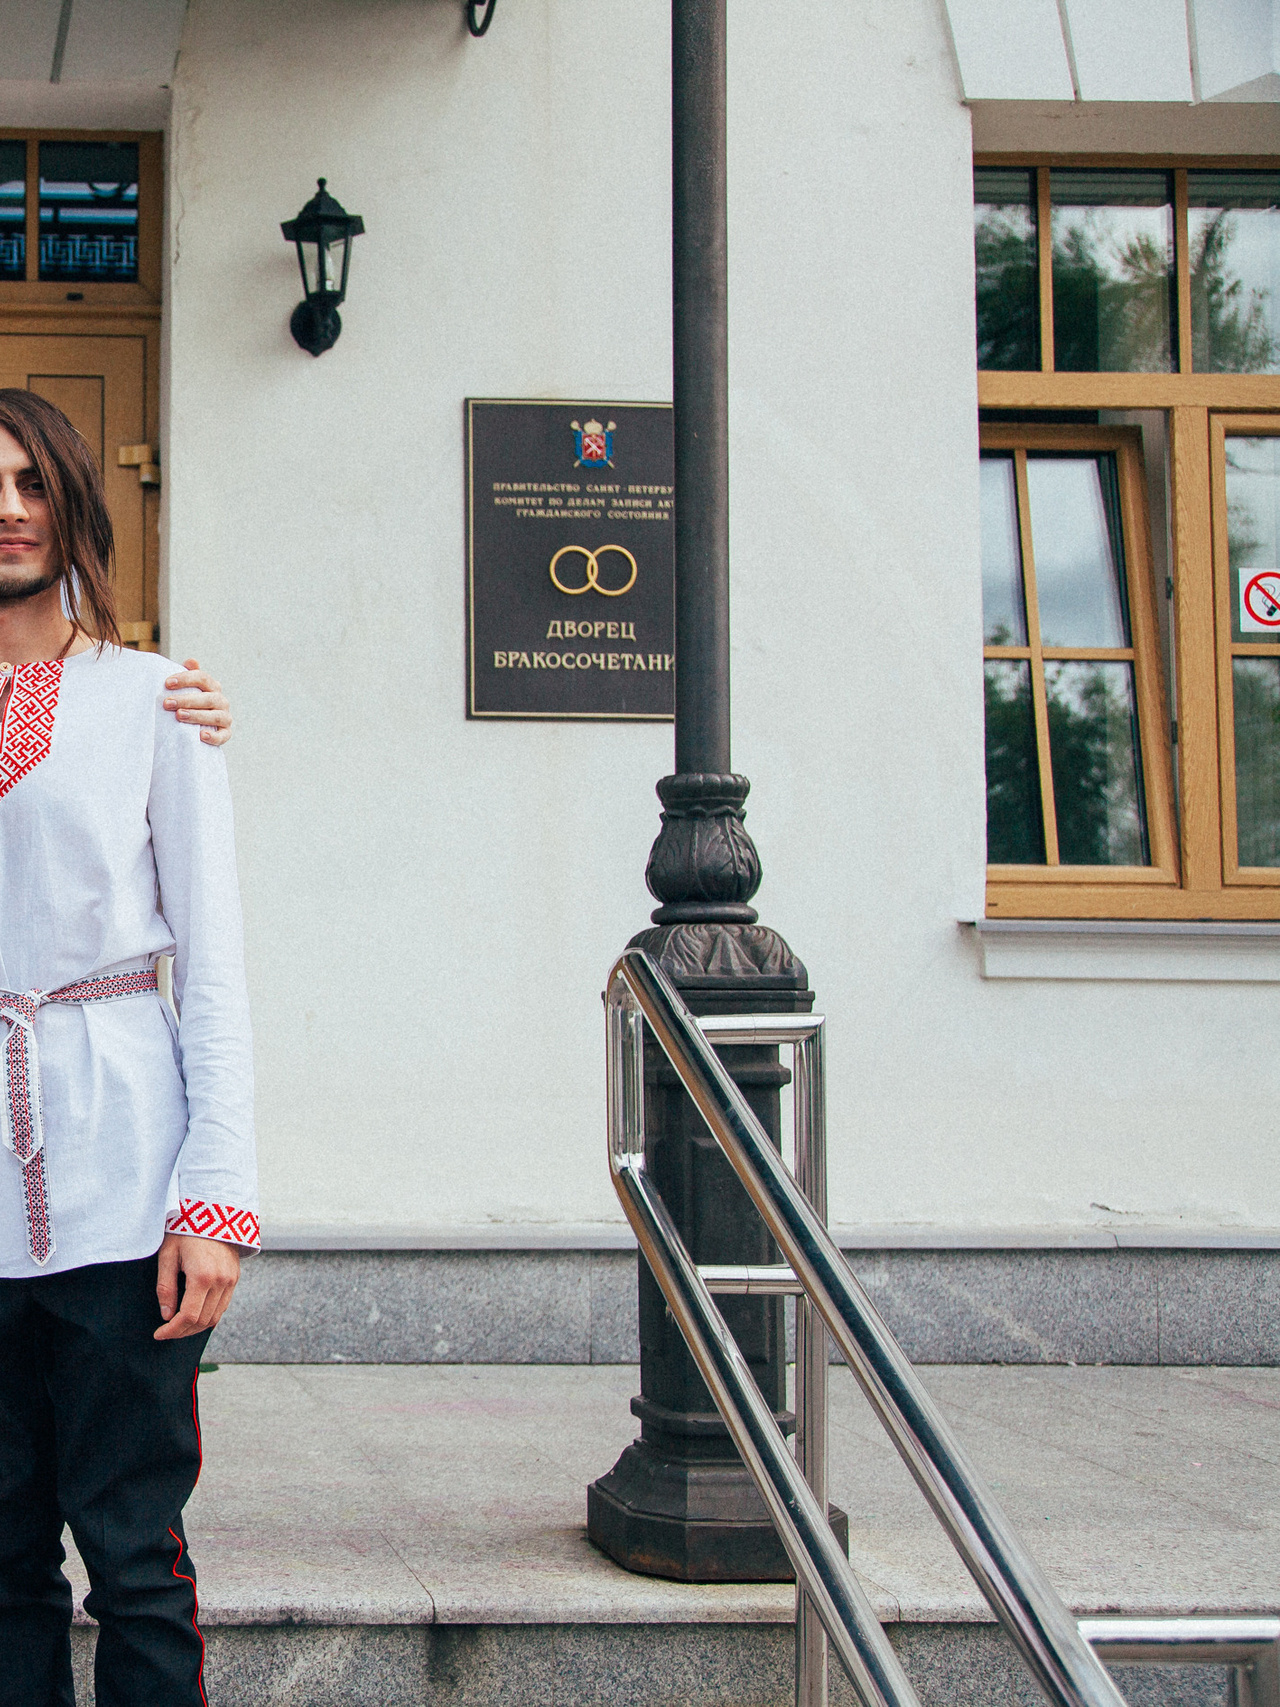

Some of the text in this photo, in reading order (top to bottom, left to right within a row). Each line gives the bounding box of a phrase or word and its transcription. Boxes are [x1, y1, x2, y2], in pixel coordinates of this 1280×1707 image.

[628, 484, 674, 495] ПЕТЕРБУ
[658, 500, 674, 509] АКТ
[546, 620, 636, 642] ДВОРЕЦ
[494, 651, 674, 672] БРАКОСОЧЕТАНИ
